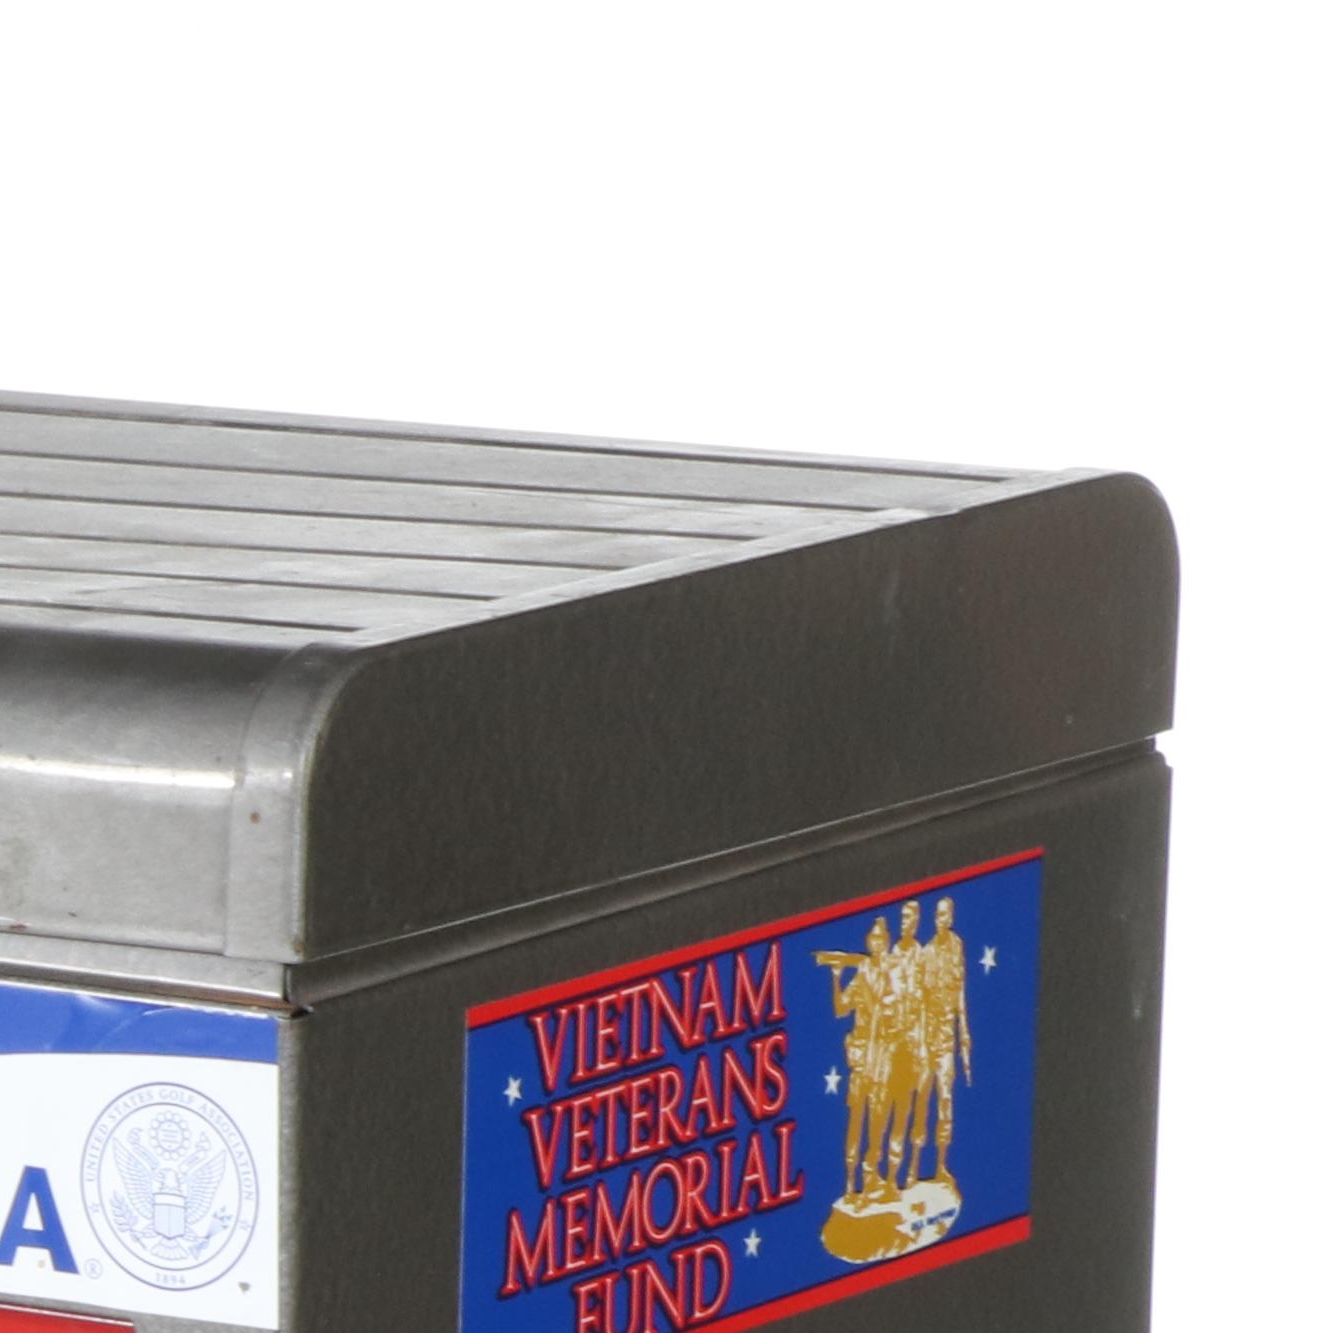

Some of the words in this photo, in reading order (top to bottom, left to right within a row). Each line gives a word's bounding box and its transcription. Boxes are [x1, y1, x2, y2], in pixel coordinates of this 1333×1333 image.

[528, 942, 787, 1091] VIETNAM
[85, 1123, 110, 1182] UNITED
[108, 1089, 154, 1122] STATES
[158, 1088, 195, 1106] GOLF
[199, 1102, 254, 1201] ASSOCIATION
[522, 1033, 790, 1189] VETERANS
[155, 1271, 187, 1285] 1894
[499, 1121, 805, 1297] MEMORIAL
